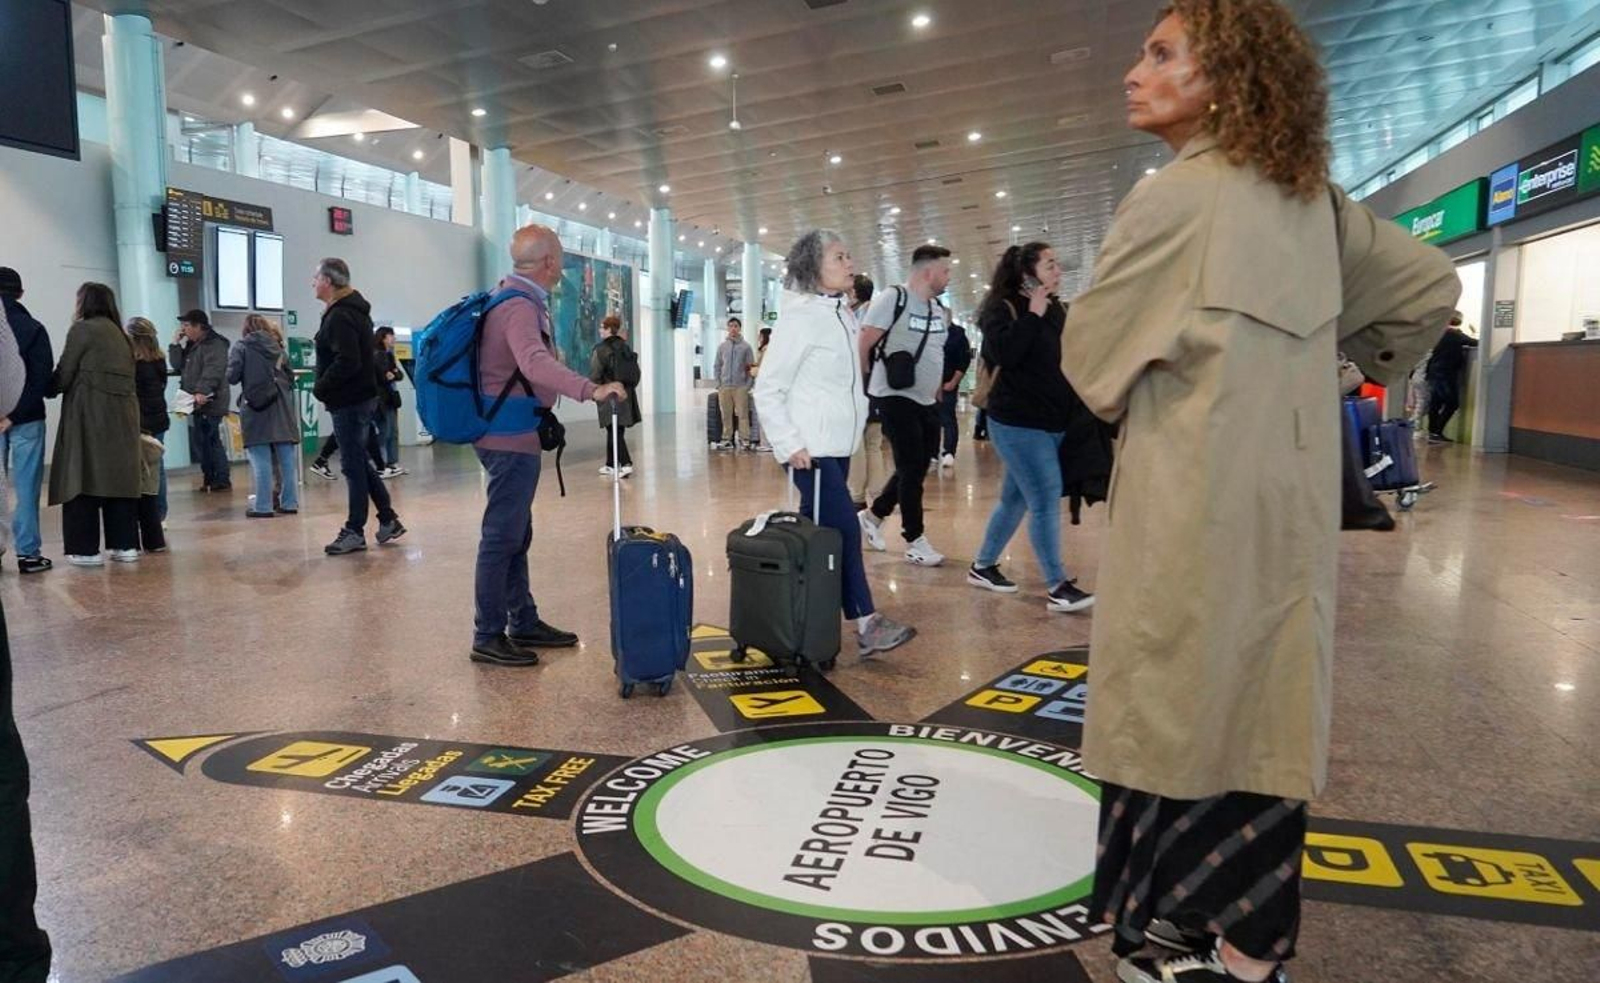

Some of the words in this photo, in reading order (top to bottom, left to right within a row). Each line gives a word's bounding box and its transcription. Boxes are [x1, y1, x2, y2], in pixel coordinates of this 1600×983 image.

[1519, 162, 1575, 193] enterprise
[983, 694, 1023, 706] P
[324, 742, 419, 789] Chegadas
[376, 750, 464, 796] Llegadas
[889, 722, 1100, 780] BIENVEN
[351, 758, 421, 793] Arrivals
[512, 784, 561, 807] TAX
[543, 757, 595, 784] FREE
[582, 745, 711, 835] WELCOME
[880, 774, 940, 818] VIGO
[783, 748, 895, 891] AEROPUERTO
[864, 828, 922, 862] DE
[1514, 862, 1567, 895] TAXI
[812, 903, 1114, 956] ENVIDOS
